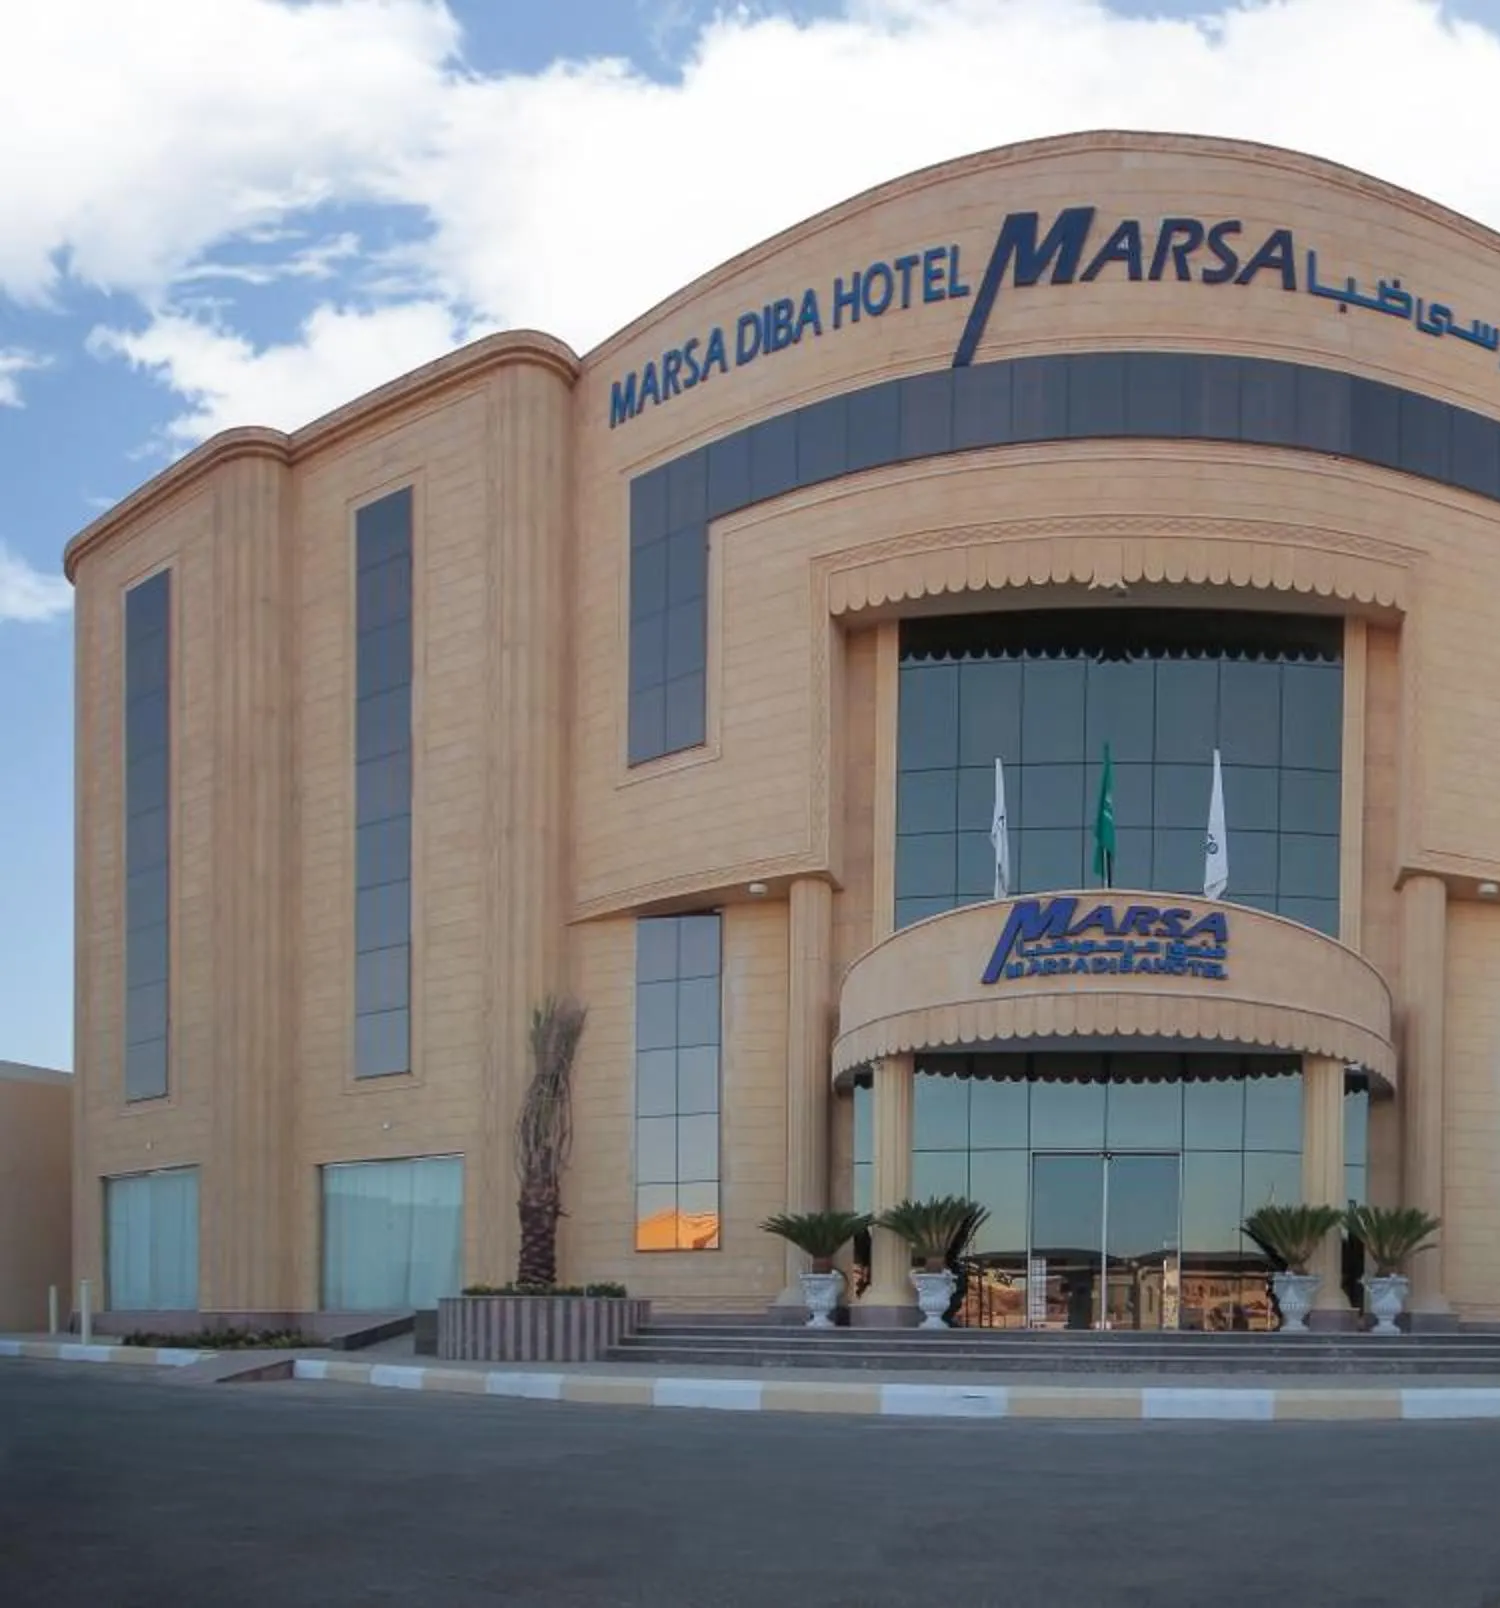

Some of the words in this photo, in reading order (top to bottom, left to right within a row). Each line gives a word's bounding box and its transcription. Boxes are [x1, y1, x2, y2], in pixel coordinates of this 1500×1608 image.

[608, 327, 728, 429] MARSA
[735, 287, 823, 367] DIBA
[832, 243, 970, 330] HOTEL
[951, 205, 1297, 368] MARSA
[1306, 249, 1412, 320] ضبا
[981, 897, 1229, 985] MARSA
